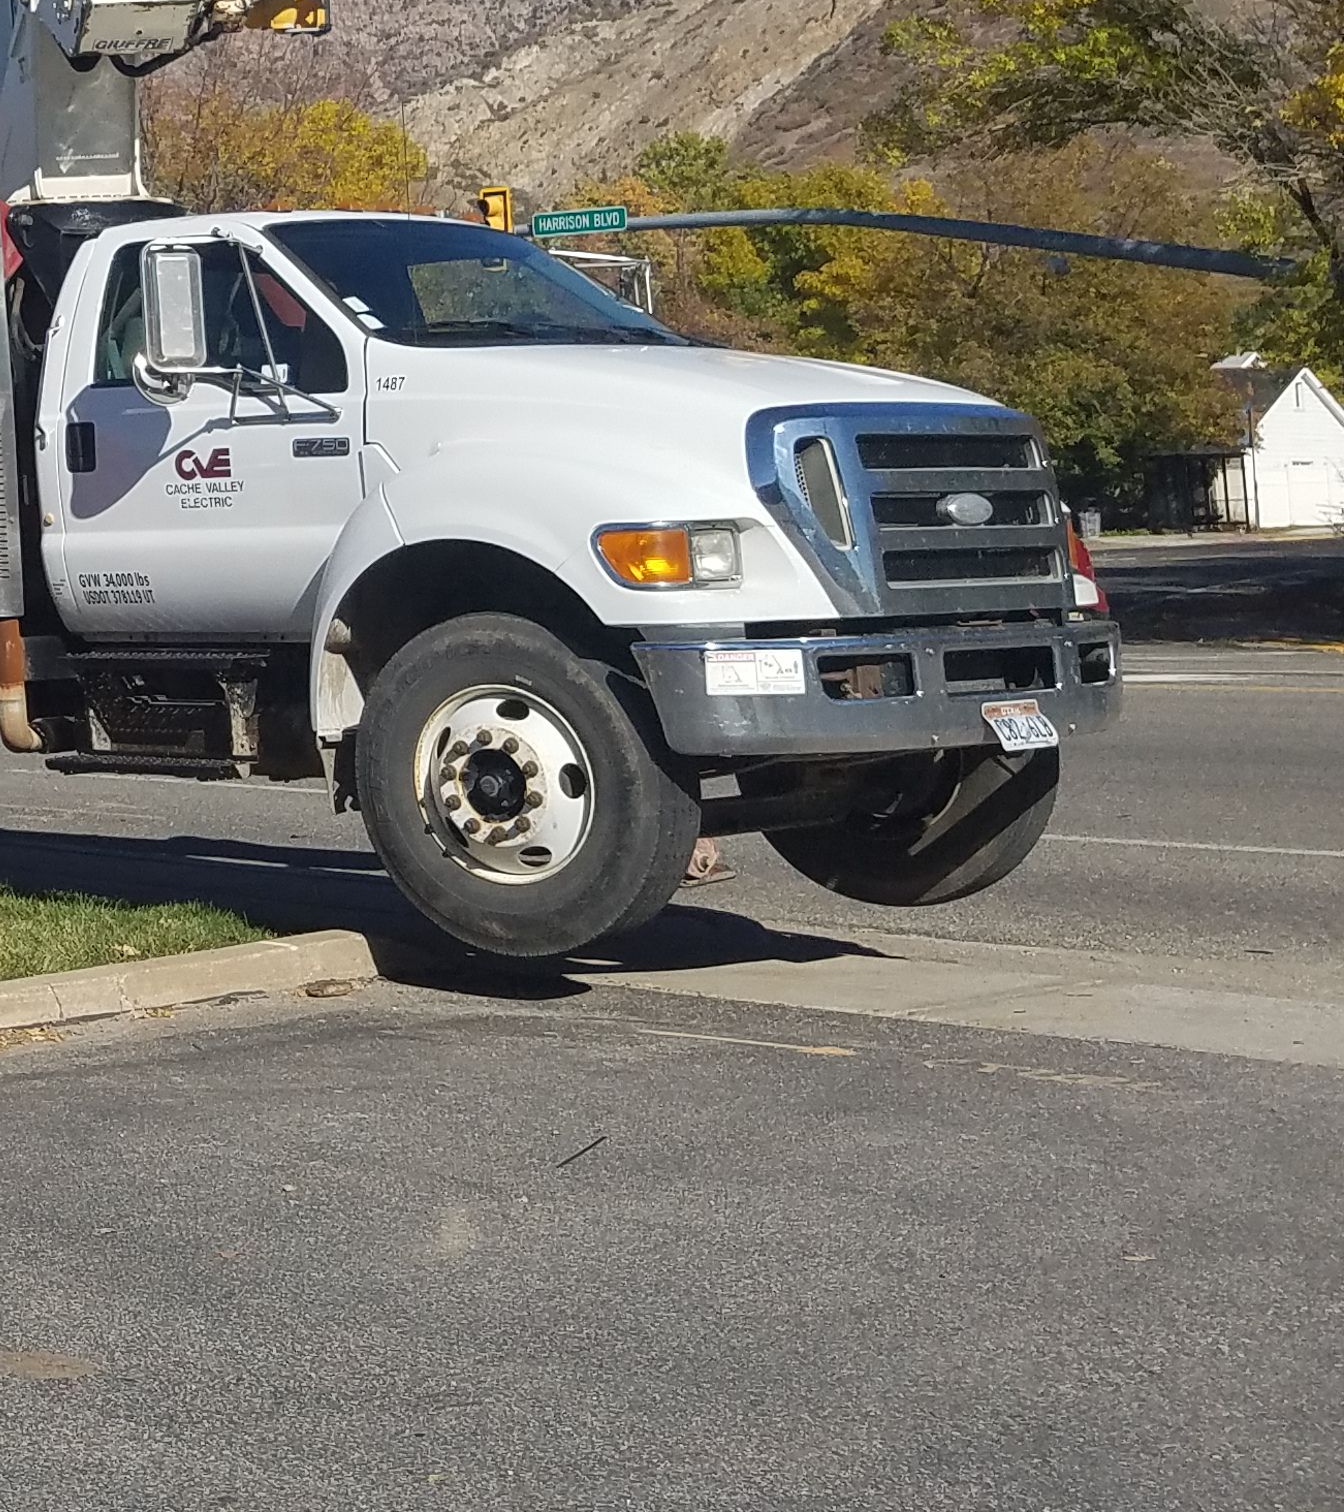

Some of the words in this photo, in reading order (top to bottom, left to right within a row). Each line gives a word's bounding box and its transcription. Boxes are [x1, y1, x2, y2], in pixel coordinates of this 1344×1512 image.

[95, 38, 171, 50] GIUFFRE
[539, 214, 590, 231] HARRISON
[593, 212, 620, 227] BLVD
[375, 377, 406, 392] 1487
[175, 448, 232, 481] CVE
[166, 483, 202, 495] CACHE
[205, 481, 245, 494] VALLEY
[180, 496, 233, 509] ELECTRIC
[79, 573, 101, 588] GVW
[103, 573, 134, 588] 34,000
[134, 572, 150, 587] lbs
[83, 590, 112, 605] USDOT
[111, 590, 143, 605] 378119
[142, 590, 155, 604] UT
